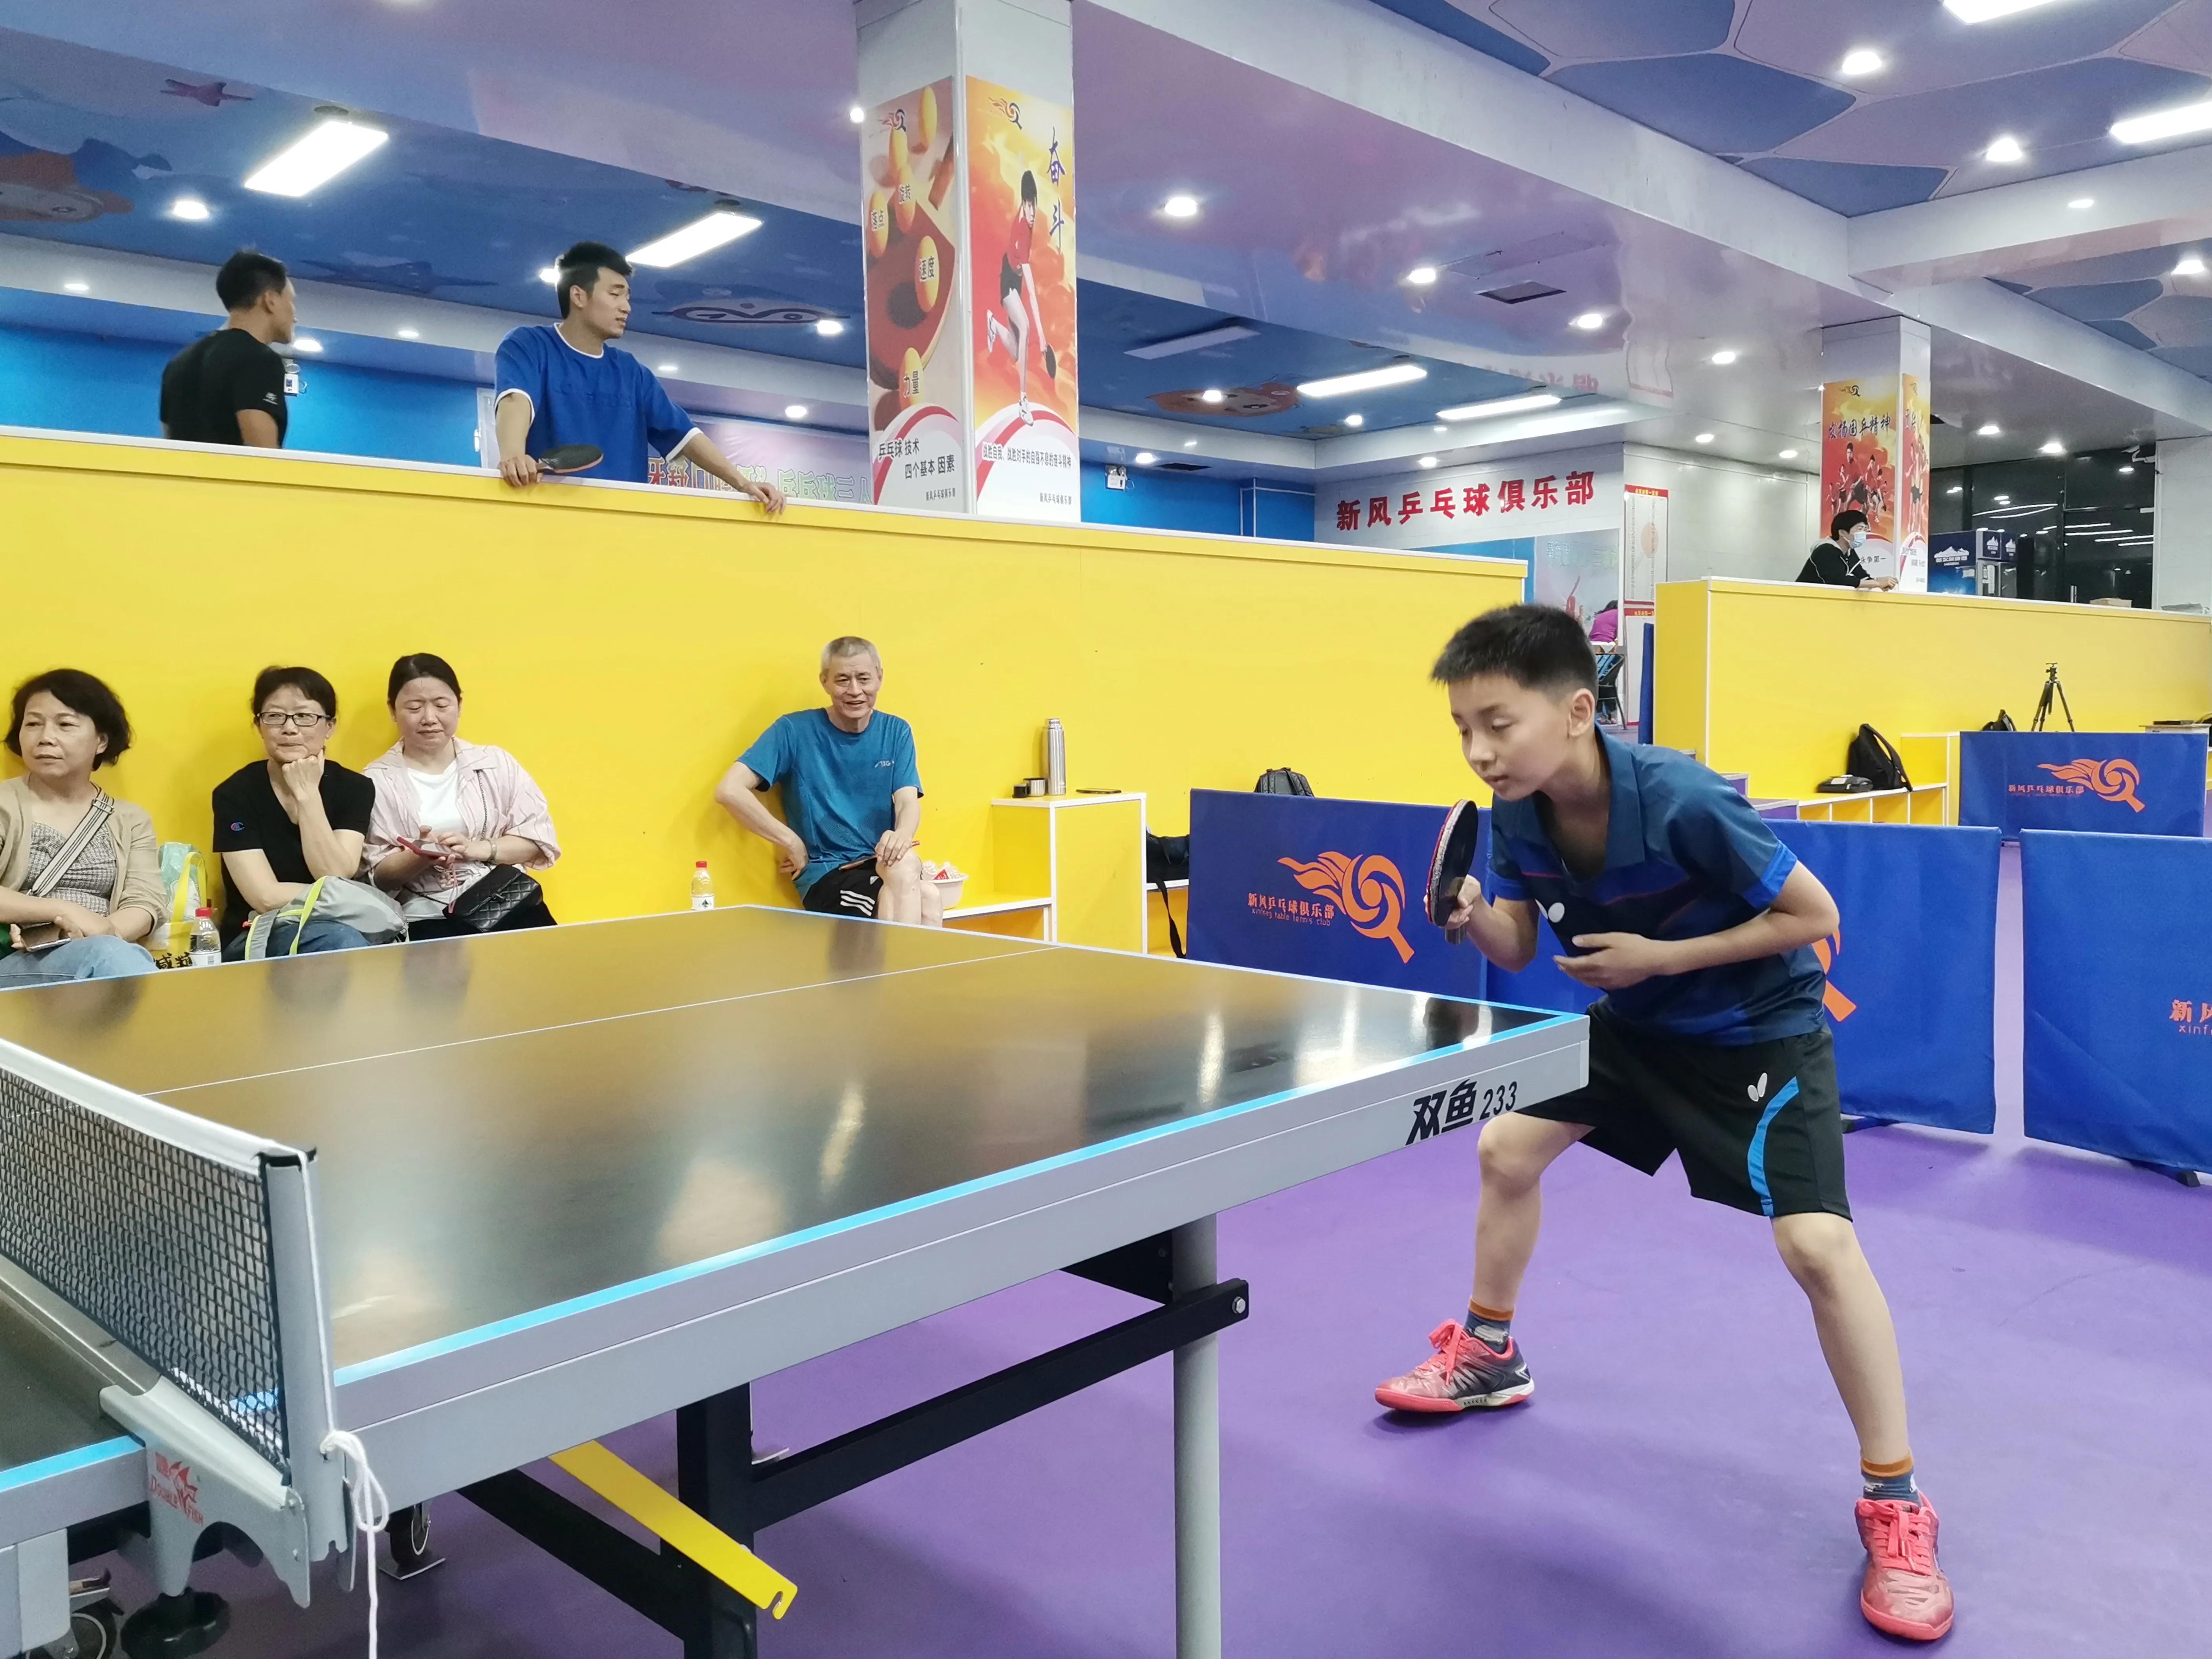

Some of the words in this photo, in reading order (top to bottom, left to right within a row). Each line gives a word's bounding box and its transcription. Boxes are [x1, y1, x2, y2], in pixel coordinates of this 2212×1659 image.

[1046, 126, 1065, 255] 奋斗
[903, 370, 920, 398] 力量
[879, 438, 920, 460] 乒乓球技术
[905, 454, 955, 479] 四个基本因素
[1336, 470, 1595, 531] 新风乒乓球俱乐部
[1247, 892, 1335, 919] 新风乒乓球俱乐部
[1275, 912, 1290, 921] table
[1316, 918, 1331, 926] club
[1405, 1078, 1478, 1146] 双鱼
[1479, 1081, 1518, 1121] 233
